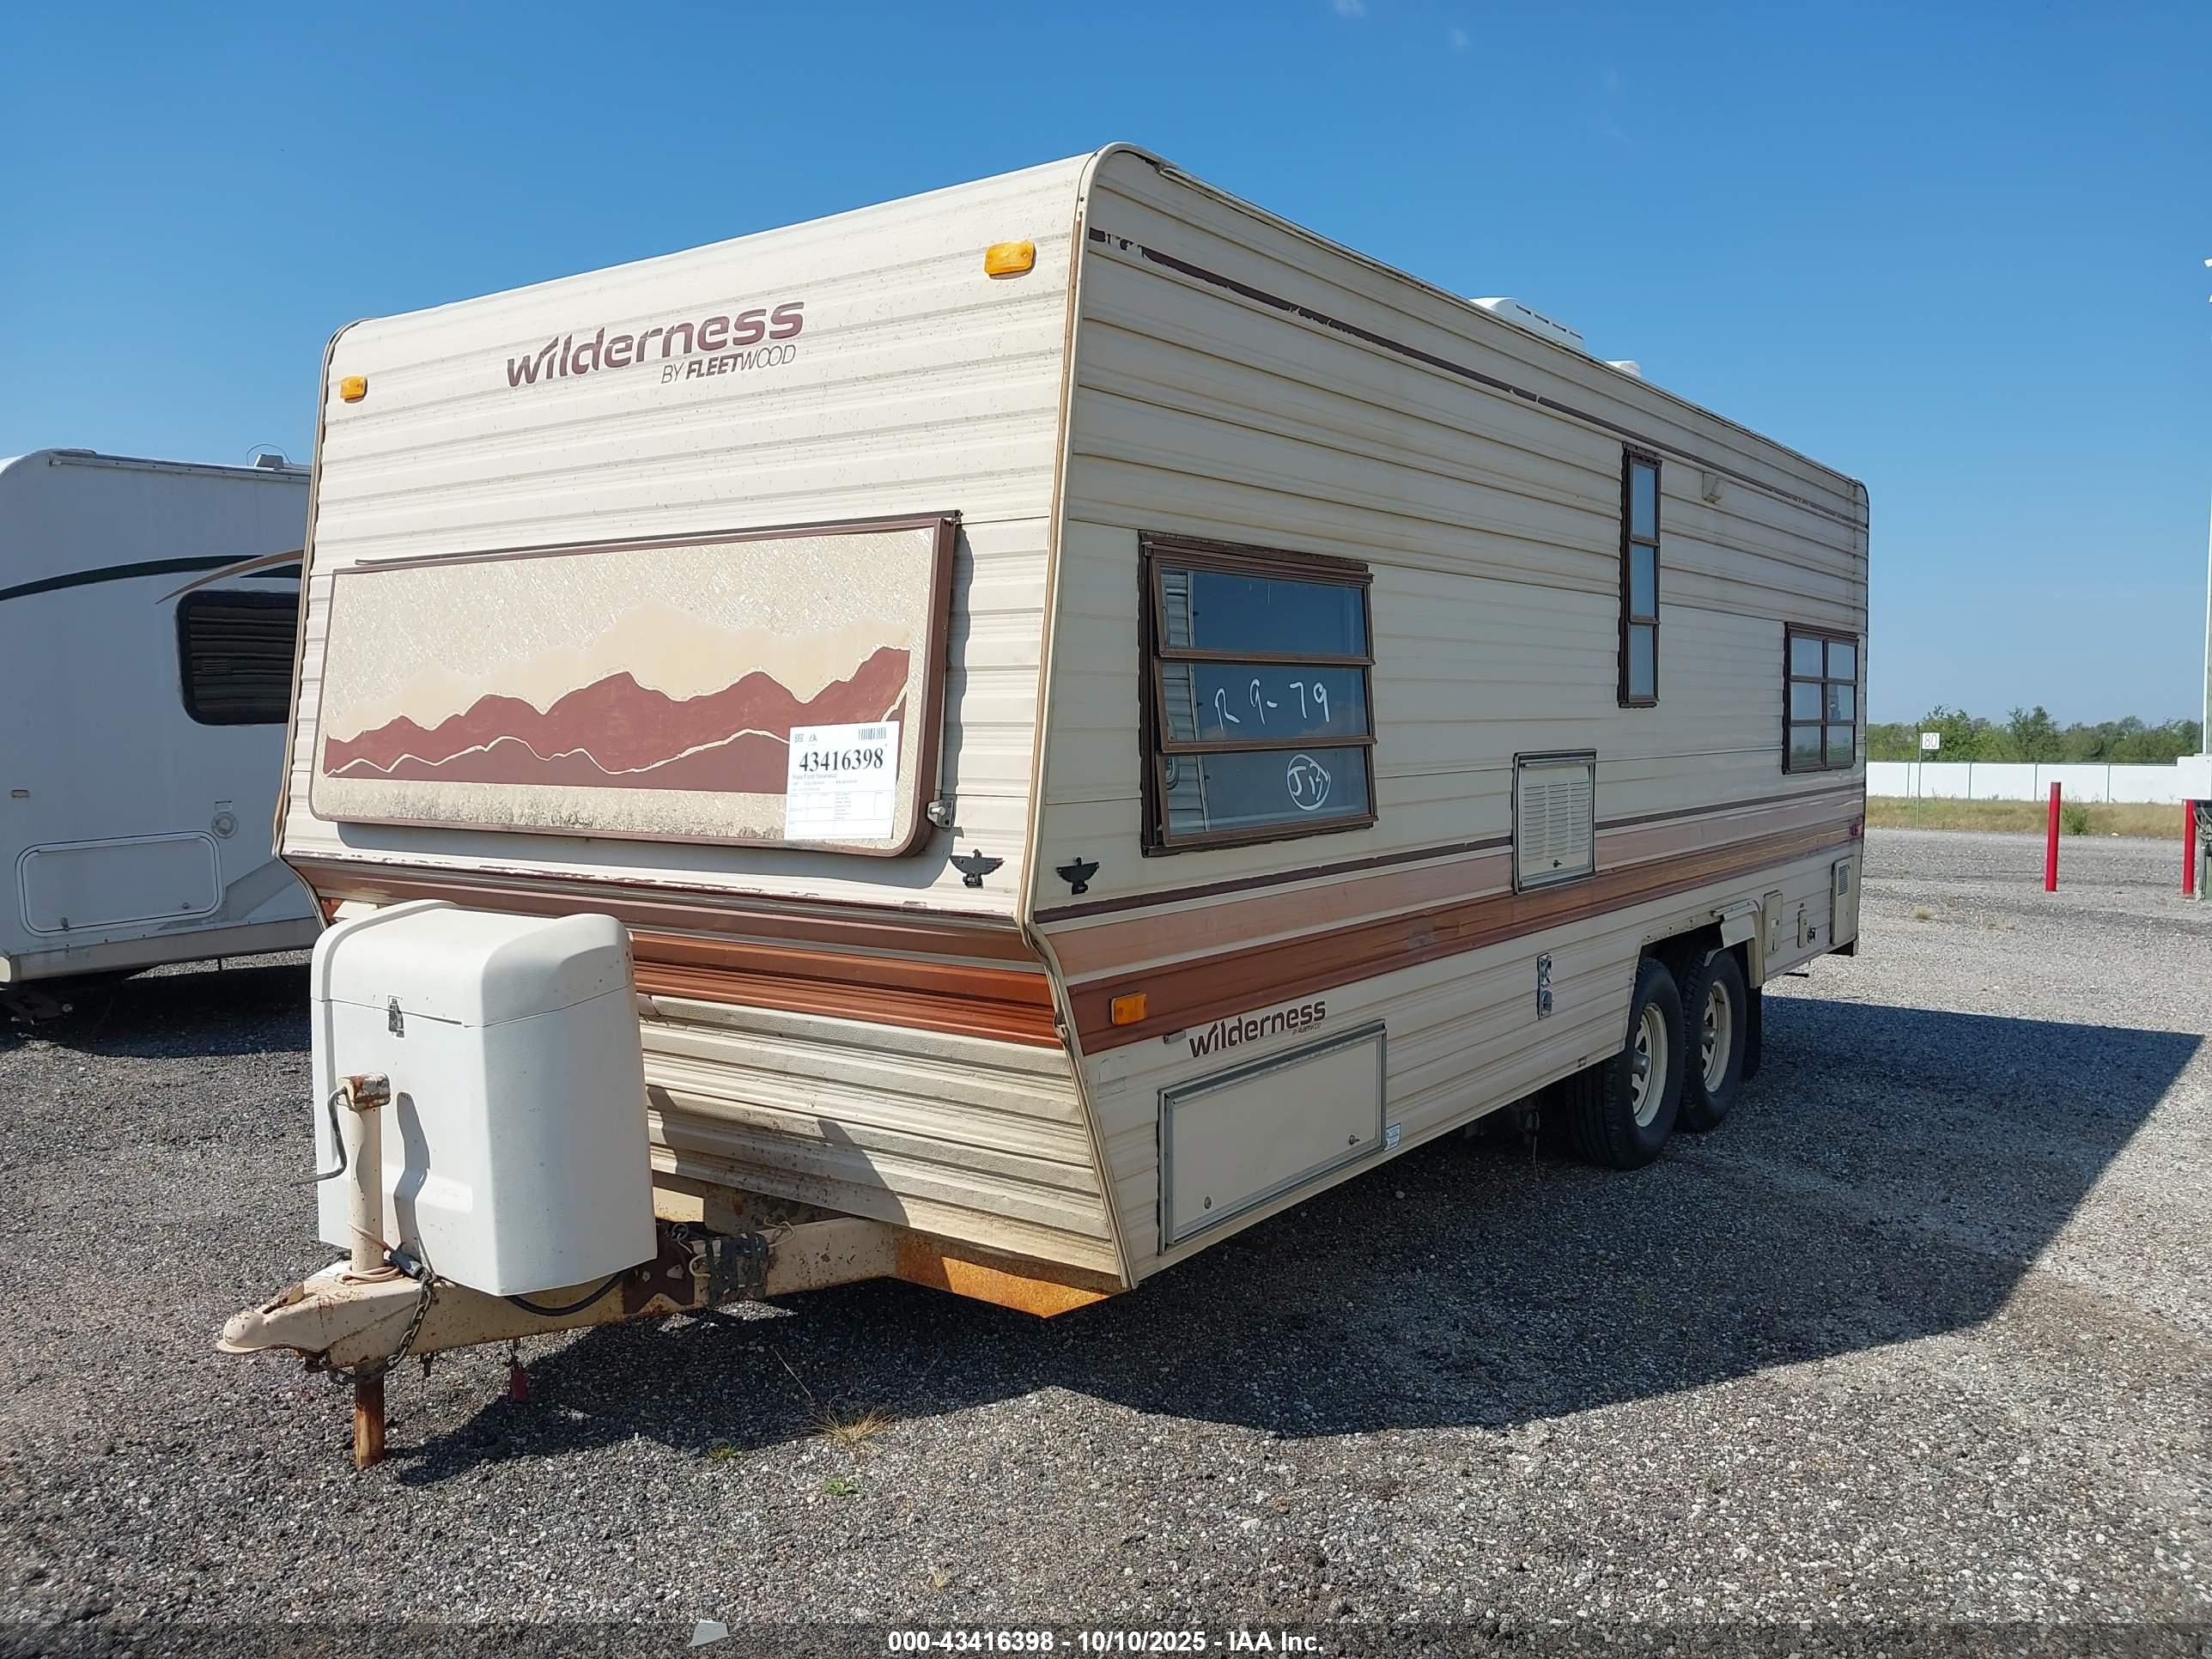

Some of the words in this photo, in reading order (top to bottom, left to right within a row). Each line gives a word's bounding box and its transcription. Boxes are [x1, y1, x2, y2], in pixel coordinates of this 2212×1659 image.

[661, 362, 684, 384] BY
[685, 344, 796, 380] FLEETWOOD
[1924, 733, 1937, 748] 80
[799, 747, 884, 772] 43416398
